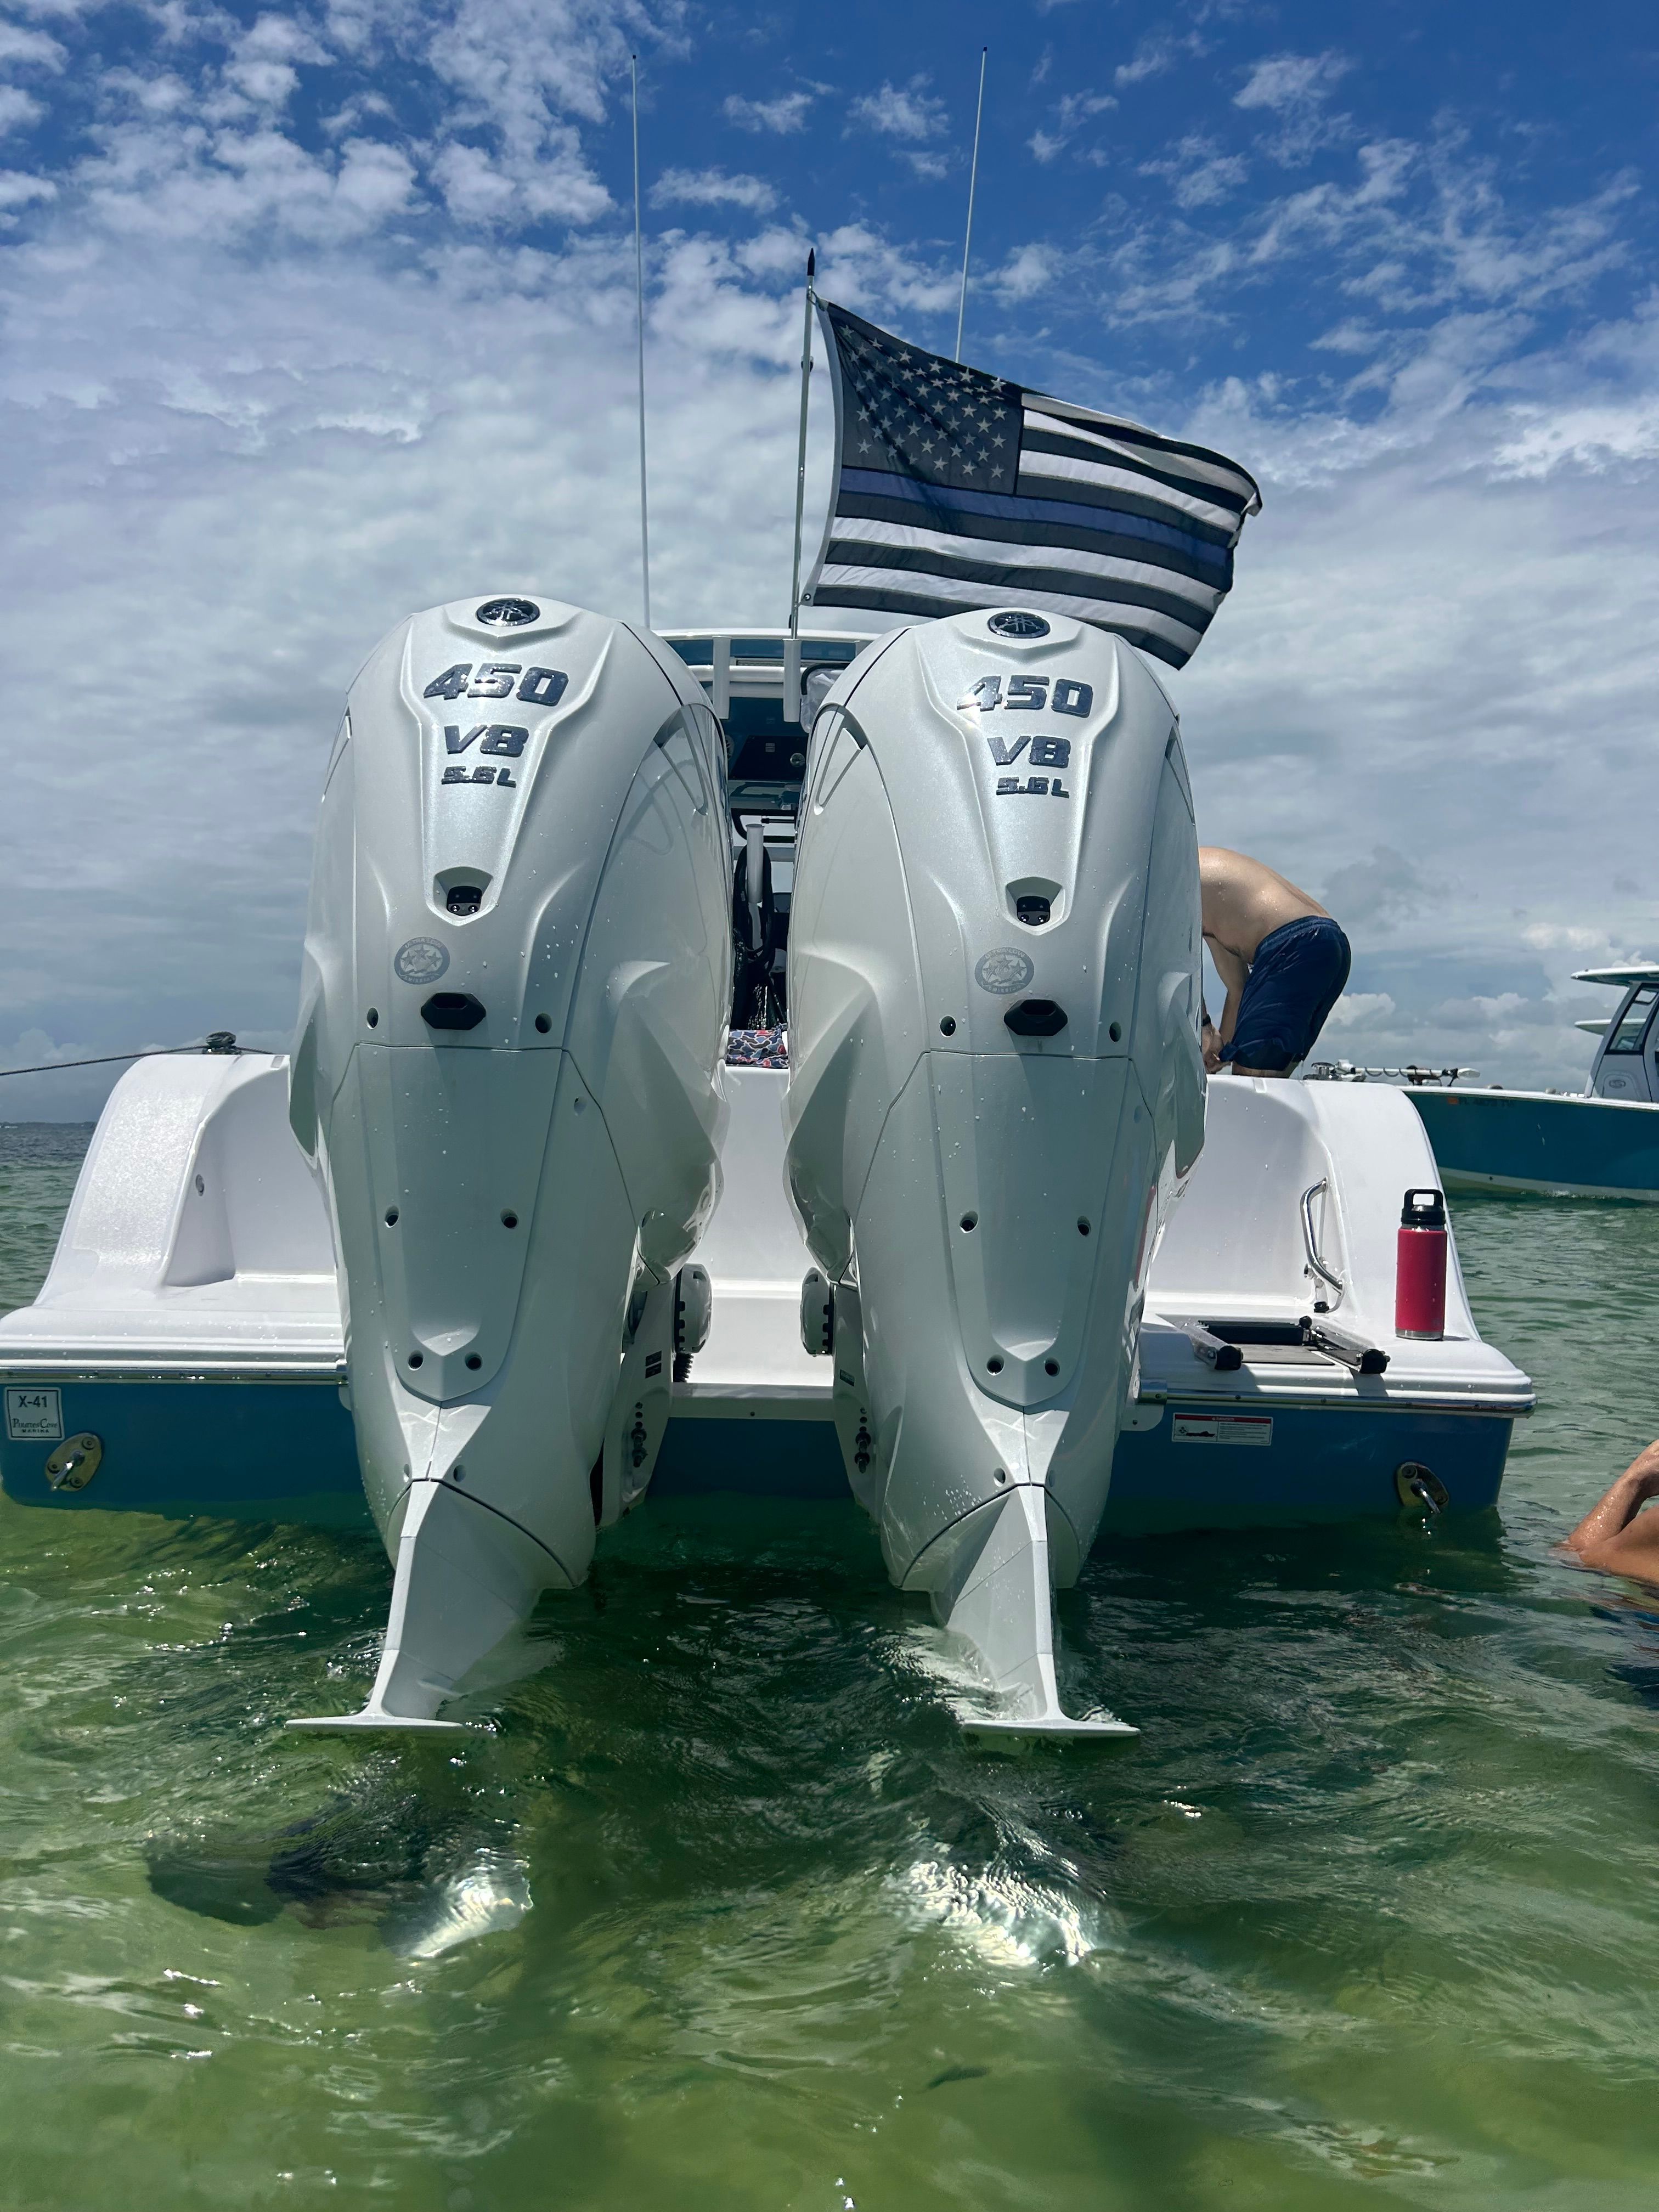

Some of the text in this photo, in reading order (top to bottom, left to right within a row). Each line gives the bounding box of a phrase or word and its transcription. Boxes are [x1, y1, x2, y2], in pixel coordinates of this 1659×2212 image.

[423, 663, 569, 707] 450
[956, 675, 1093, 718] 450
[444, 724, 529, 758] V8
[987, 735, 1071, 769] V8
[441, 766, 517, 788] 5.6L
[996, 776, 1070, 798] 5.6L
[18, 1395, 48, 1408] X-41
